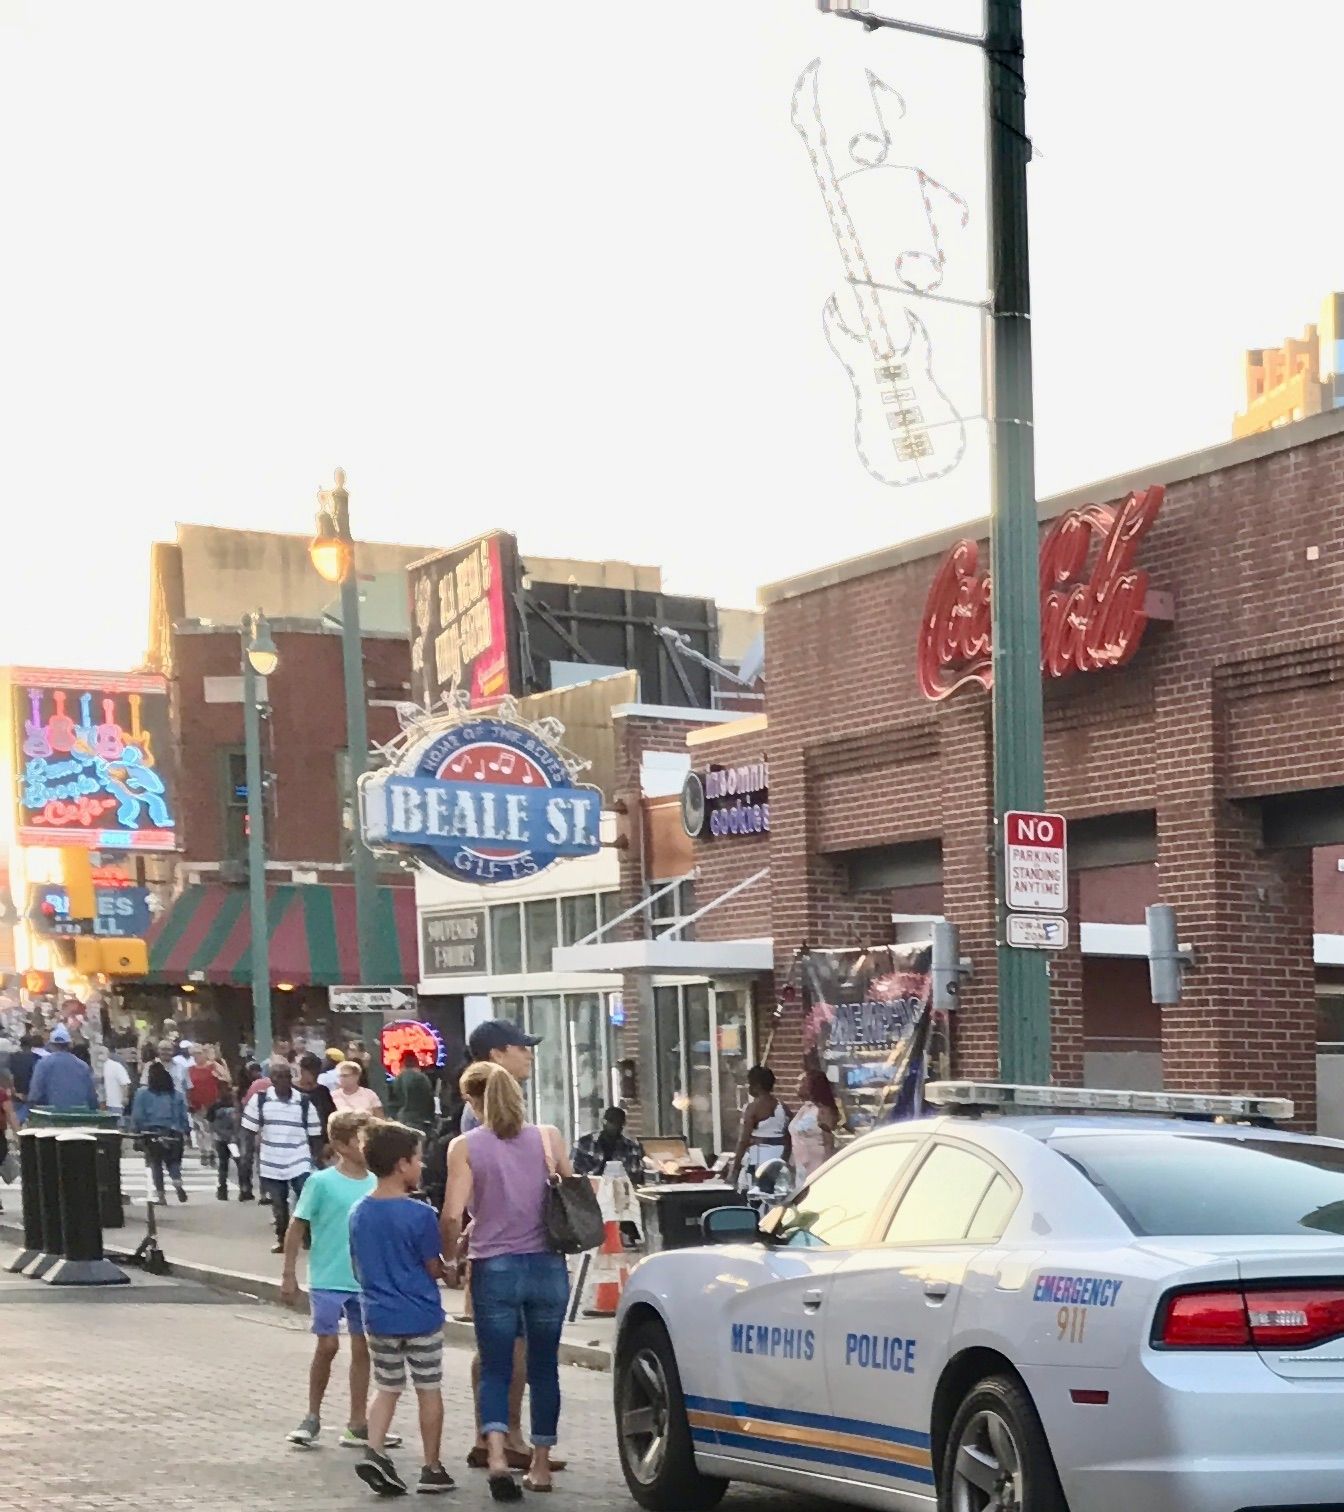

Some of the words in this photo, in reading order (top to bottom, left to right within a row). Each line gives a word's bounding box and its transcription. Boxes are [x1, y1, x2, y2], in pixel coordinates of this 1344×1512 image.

[917, 484, 1166, 700] CoCola
[390, 785, 530, 843] BEALE
[1017, 818, 1054, 842] NO
[454, 851, 539, 879] GIFTS
[1012, 848, 1060, 864] PARKING
[1012, 866, 1061, 881] STANDING
[1014, 882, 1060, 896] ANYTIME
[1032, 1275, 1123, 1307] EMERGENCY
[1057, 1306, 1087, 1343] 911
[731, 1322, 816, 1362] MEMPHIS
[845, 1332, 916, 1374] POLICE
